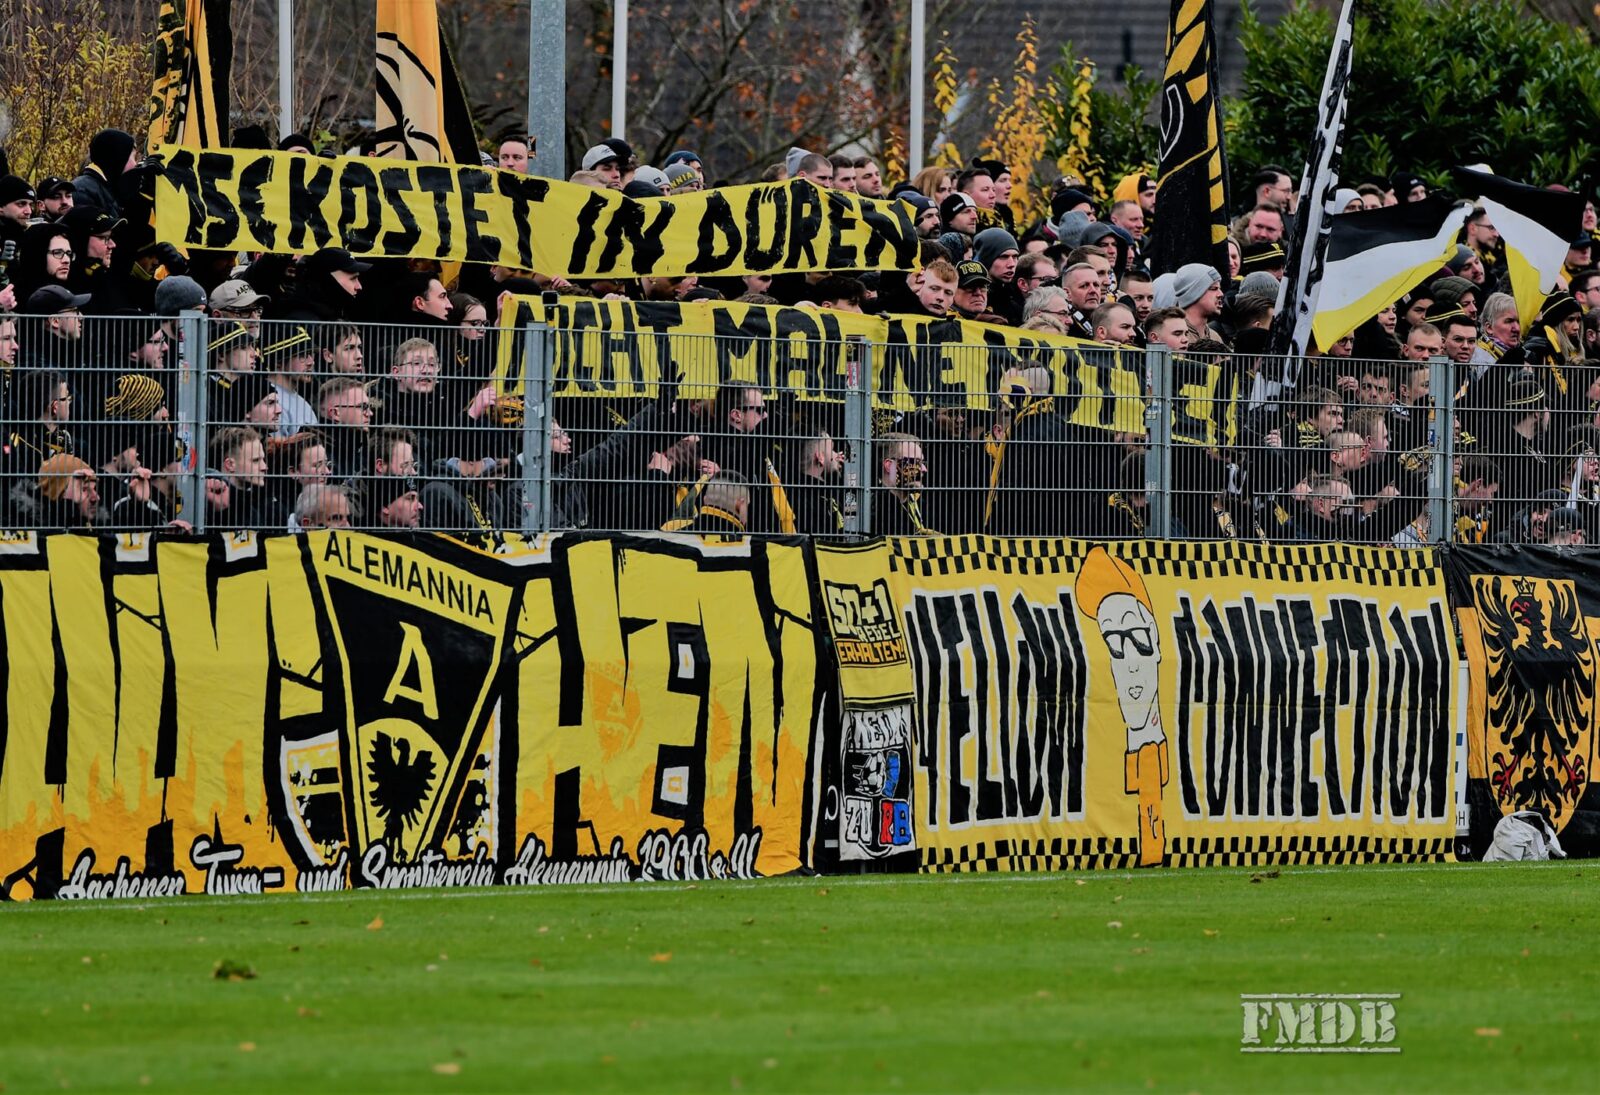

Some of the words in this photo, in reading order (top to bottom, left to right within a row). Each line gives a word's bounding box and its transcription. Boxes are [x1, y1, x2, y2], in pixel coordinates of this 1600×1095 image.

[288, 157, 550, 268] KOSTET
[568, 190, 675, 274] IN
[685, 179, 918, 272] DÜREN
[713, 306, 848, 401] MAL
[879, 318, 968, 409] NE
[324, 531, 494, 625] ALEMANNIA
[826, 584, 893, 635] 50+1
[384, 621, 439, 719] A
[836, 637, 905, 663] ERHALTEN!
[856, 620, 901, 642] REGEL
[1173, 595, 1451, 820] CONNECTION
[846, 799, 872, 842] ZU
[880, 799, 911, 845] RB
